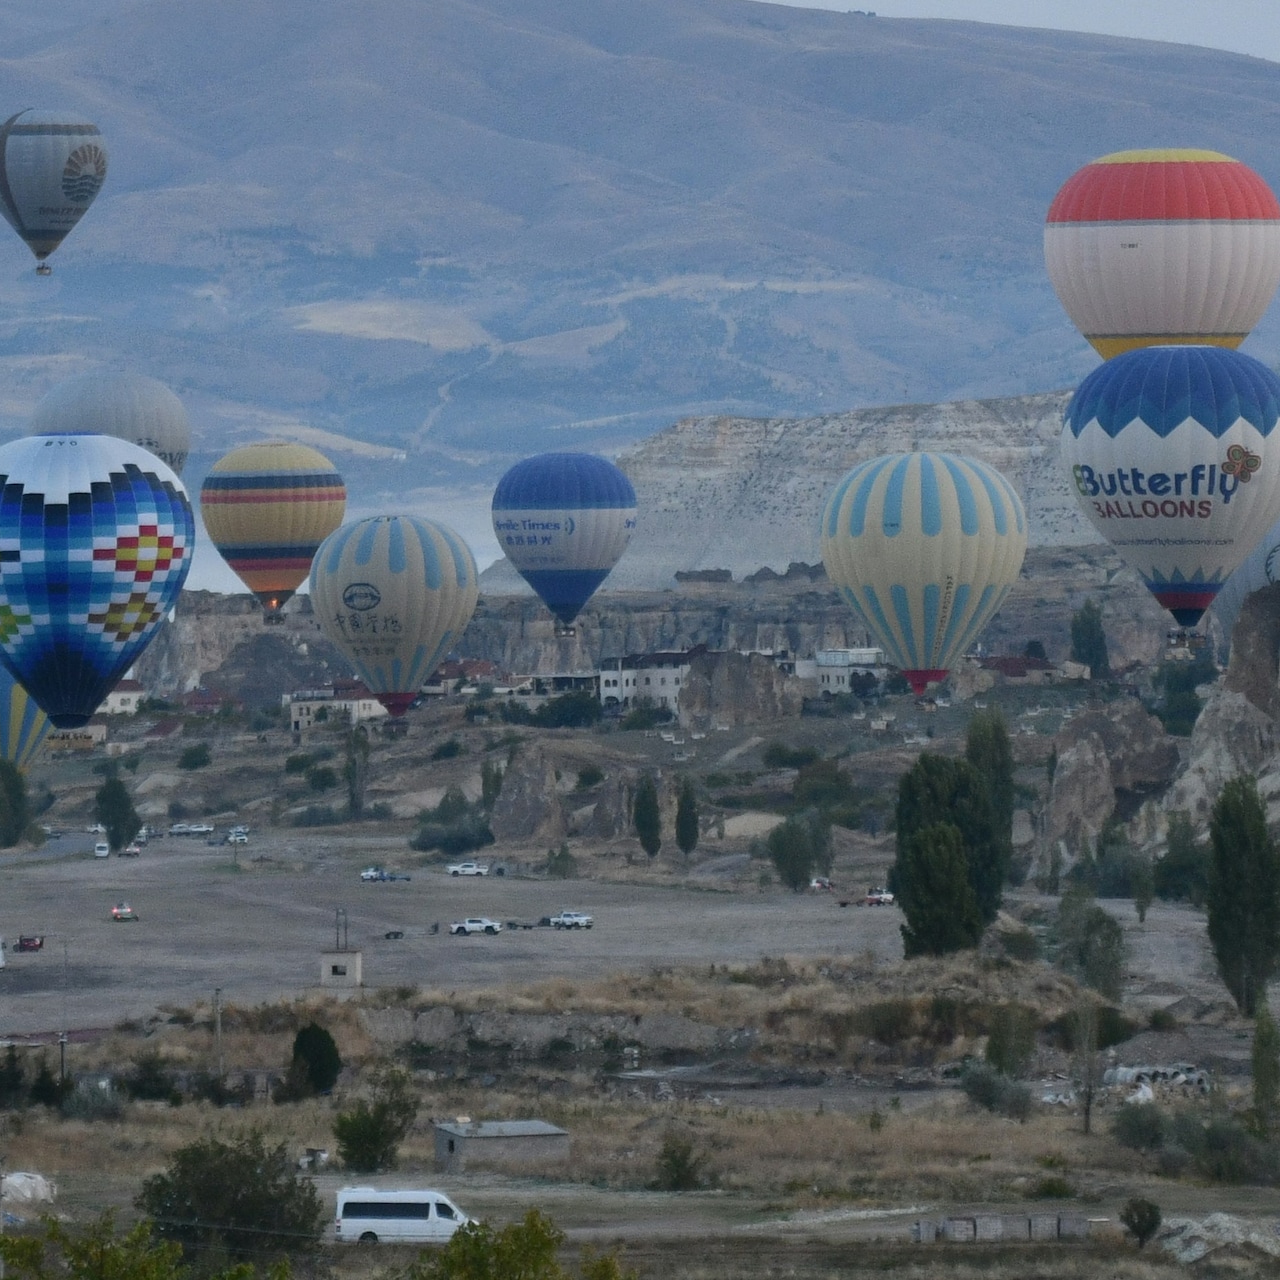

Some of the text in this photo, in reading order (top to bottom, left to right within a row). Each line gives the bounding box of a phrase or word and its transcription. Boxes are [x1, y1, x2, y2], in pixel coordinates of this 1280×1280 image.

[1074, 464, 1240, 504] Butterfly
[1094, 500, 1212, 519] BALLOONS
[521, 519, 560, 531] Times
